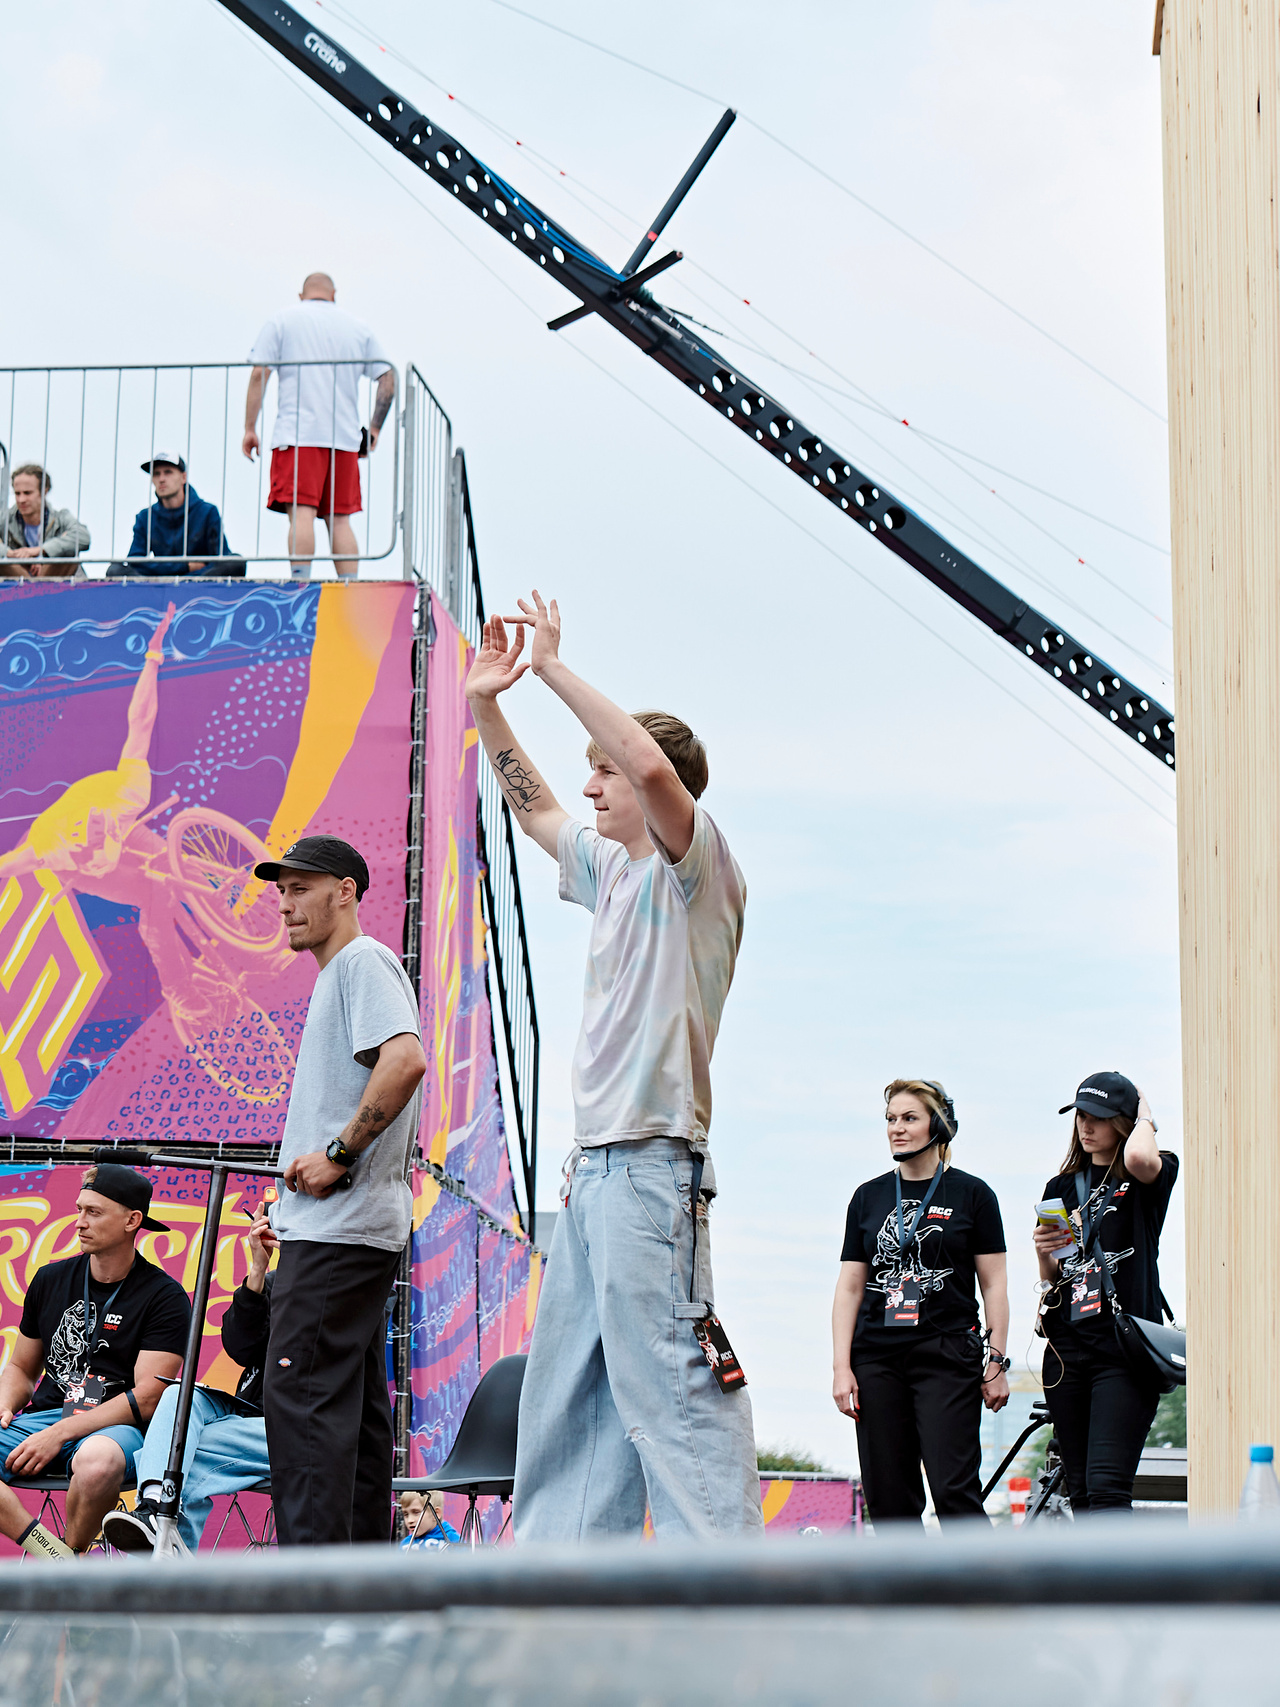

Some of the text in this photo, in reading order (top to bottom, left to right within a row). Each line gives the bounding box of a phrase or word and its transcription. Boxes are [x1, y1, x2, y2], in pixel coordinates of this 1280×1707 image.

[303, 31, 347, 75] Crane
[928, 1205, 953, 1217] RCC
[32, 1528, 50, 1548] BIDLO
